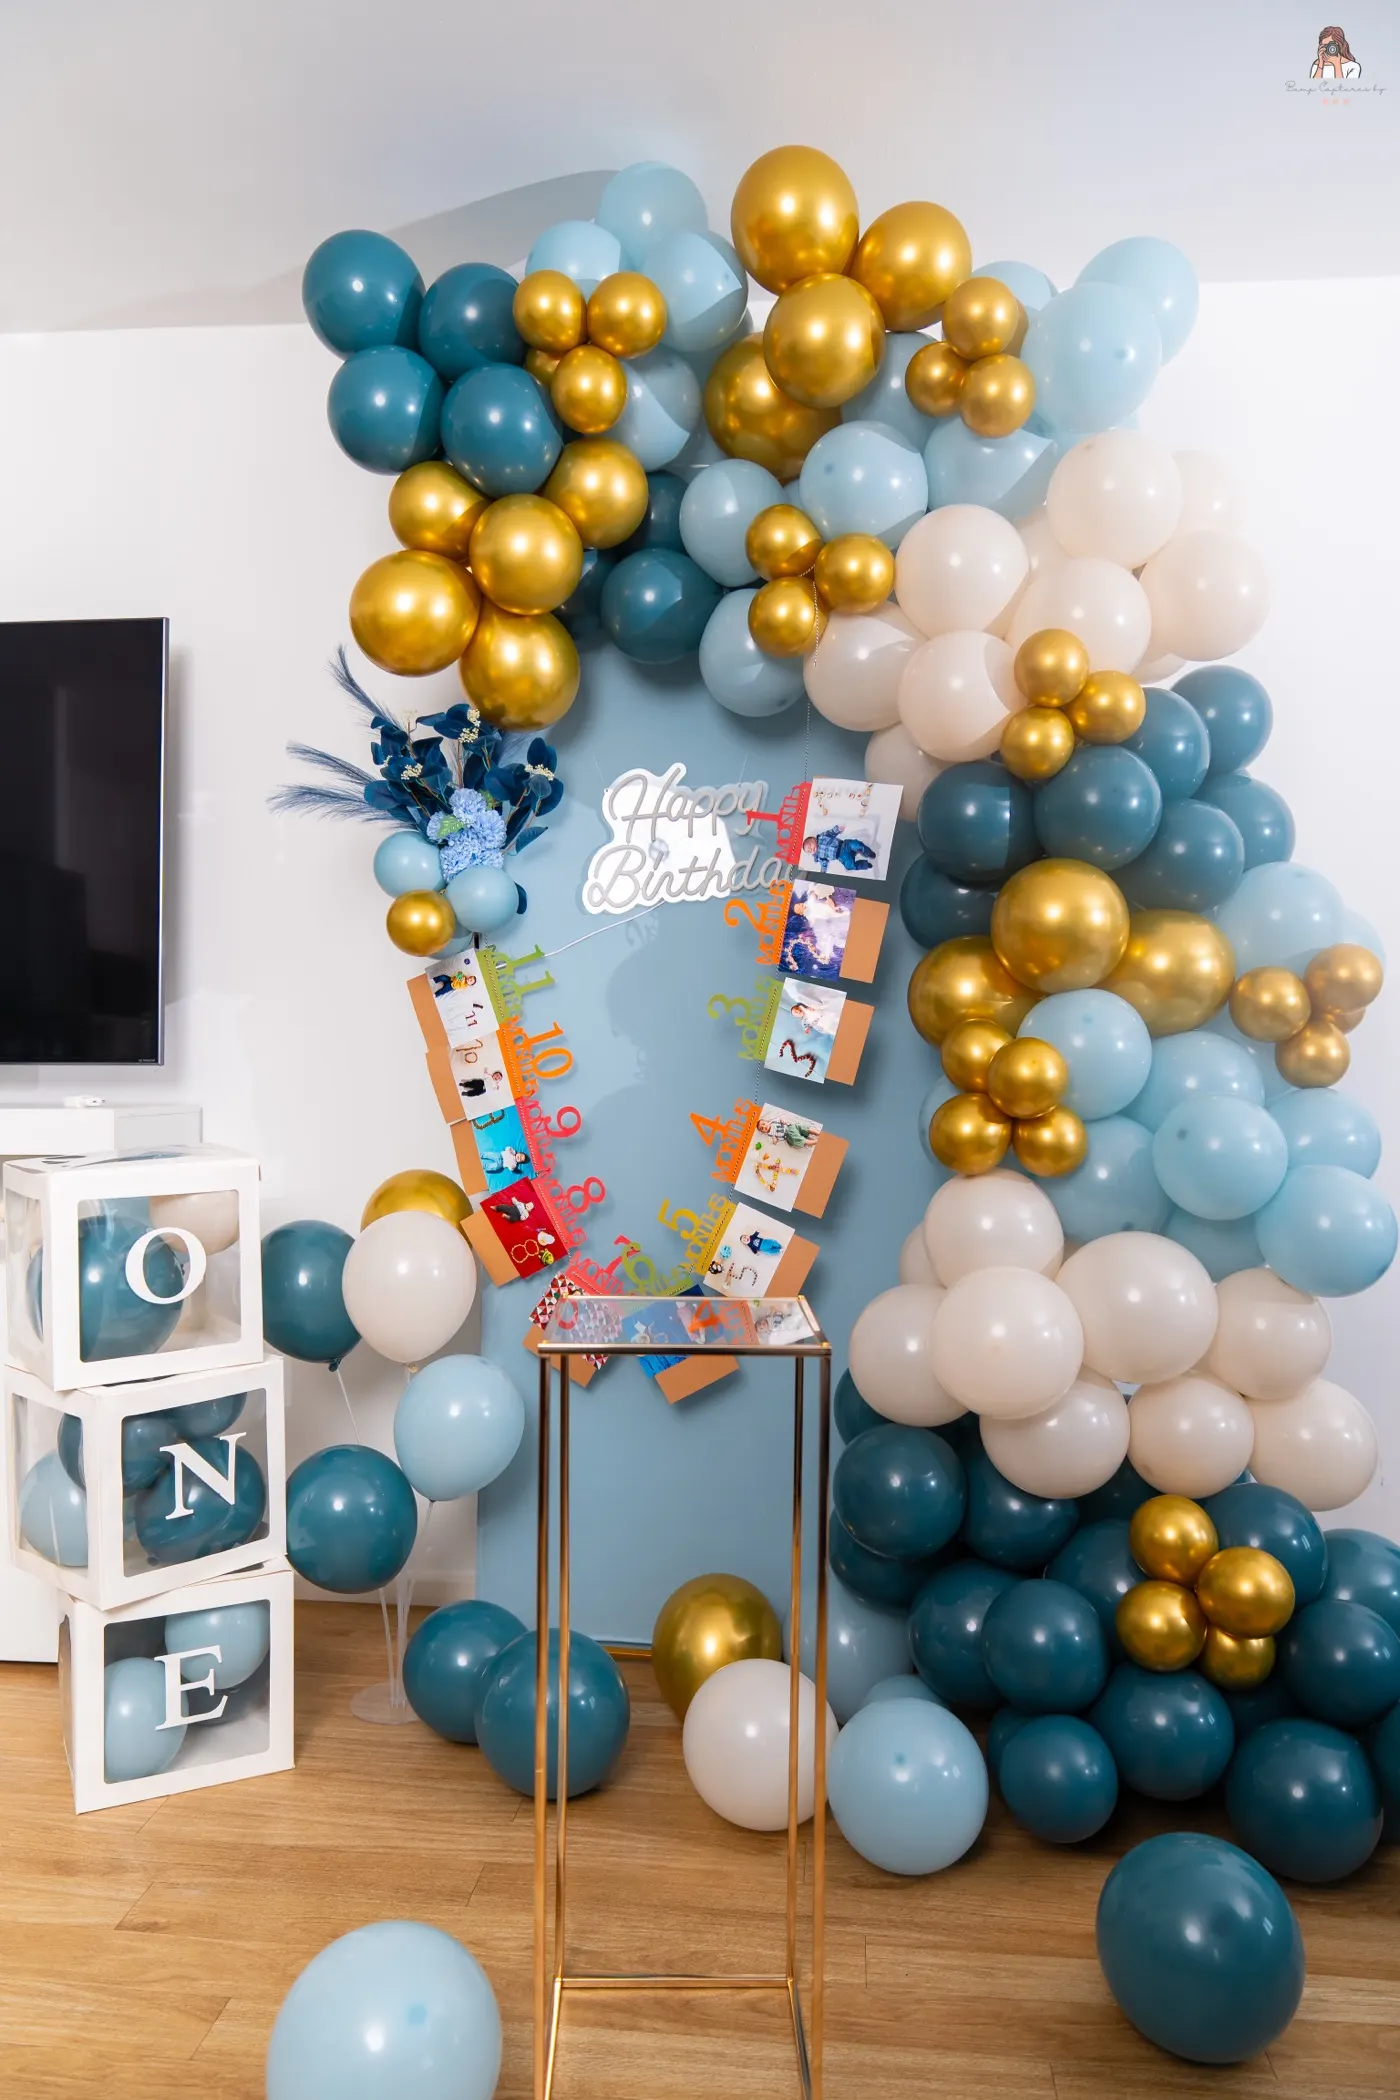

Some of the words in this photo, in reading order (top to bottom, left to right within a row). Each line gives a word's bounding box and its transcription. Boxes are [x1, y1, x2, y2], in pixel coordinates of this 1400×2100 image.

[607, 766, 762, 844] Happy
[746, 810, 781, 826] 1
[774, 784, 802, 862] MONTH
[587, 844, 808, 908] Birthda
[724, 898, 768, 932] 2
[756, 879, 790, 965] MONTHS
[512, 943, 556, 997] 11
[707, 993, 749, 1027] 3
[738, 974, 775, 1061] MONTHS
[504, 1015, 540, 1097] MONTHS
[528, 1020, 574, 1080] 10
[542, 1105, 582, 1139] 9
[690, 1112, 728, 1148] 4
[710, 1097, 752, 1184] MONTHS
[565, 1176, 606, 1214] 8
[656, 1198, 700, 1242] 5
[604, 1234, 641, 1275] 7
[678, 1193, 729, 1272] MONTHS
[621, 1241, 656, 1286] 6
